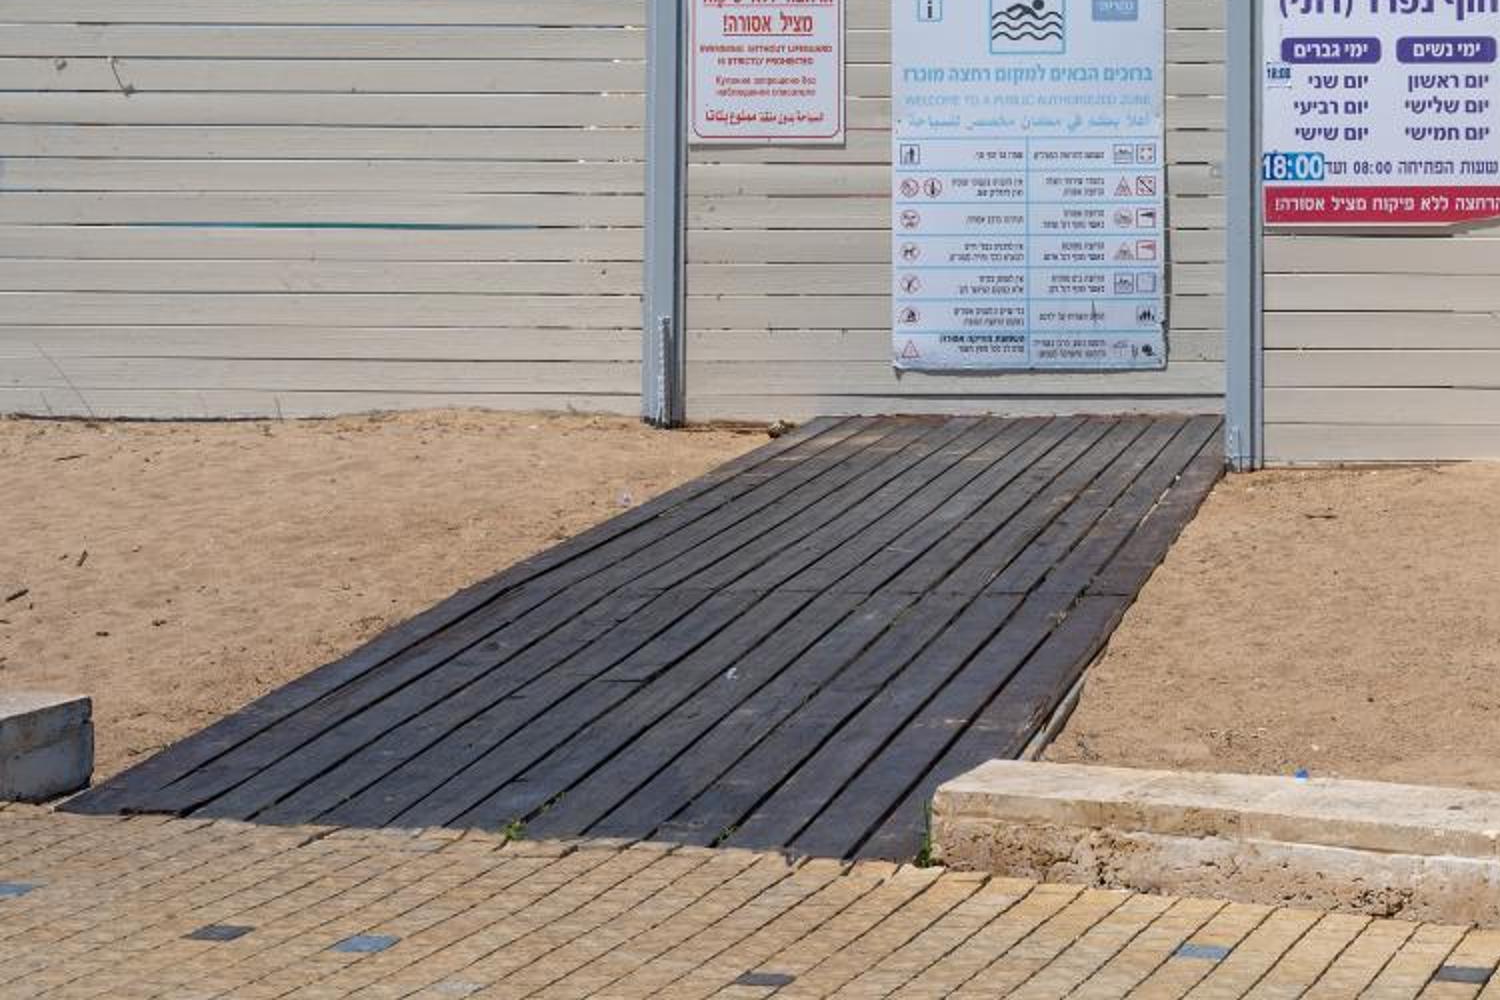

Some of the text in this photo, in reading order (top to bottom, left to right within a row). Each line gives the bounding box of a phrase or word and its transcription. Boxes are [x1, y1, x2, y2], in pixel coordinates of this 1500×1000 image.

[722, 10, 814, 33] מציל אסורה!
[1293, 43, 1369, 59] ימי גברים
[1412, 43, 1481, 57] ימי נשים
[994, 63, 1047, 86] למקום
[1049, 66, 1100, 82] הבאים
[1307, 74, 1369, 90] יום שני
[1407, 74, 1490, 93] יום ראשון
[1293, 100, 1369, 115] יום רביעי
[1404, 95, 1490, 114] יום שלישי
[1294, 126, 1369, 142] יום שישי
[1404, 126, 1490, 141] יום חמישי
[1263, 154, 1323, 179] 18:00
[1352, 160, 1393, 176] 08:00
[1397, 160, 1455, 175] הפתיחה
[1459, 160, 1499, 175] שעות
[1275, 196, 1326, 213] אסורה!
[1331, 194, 1367, 212] מציל
[1372, 196, 1415, 214] פיקוח
[1420, 194, 1449, 212] ללא
